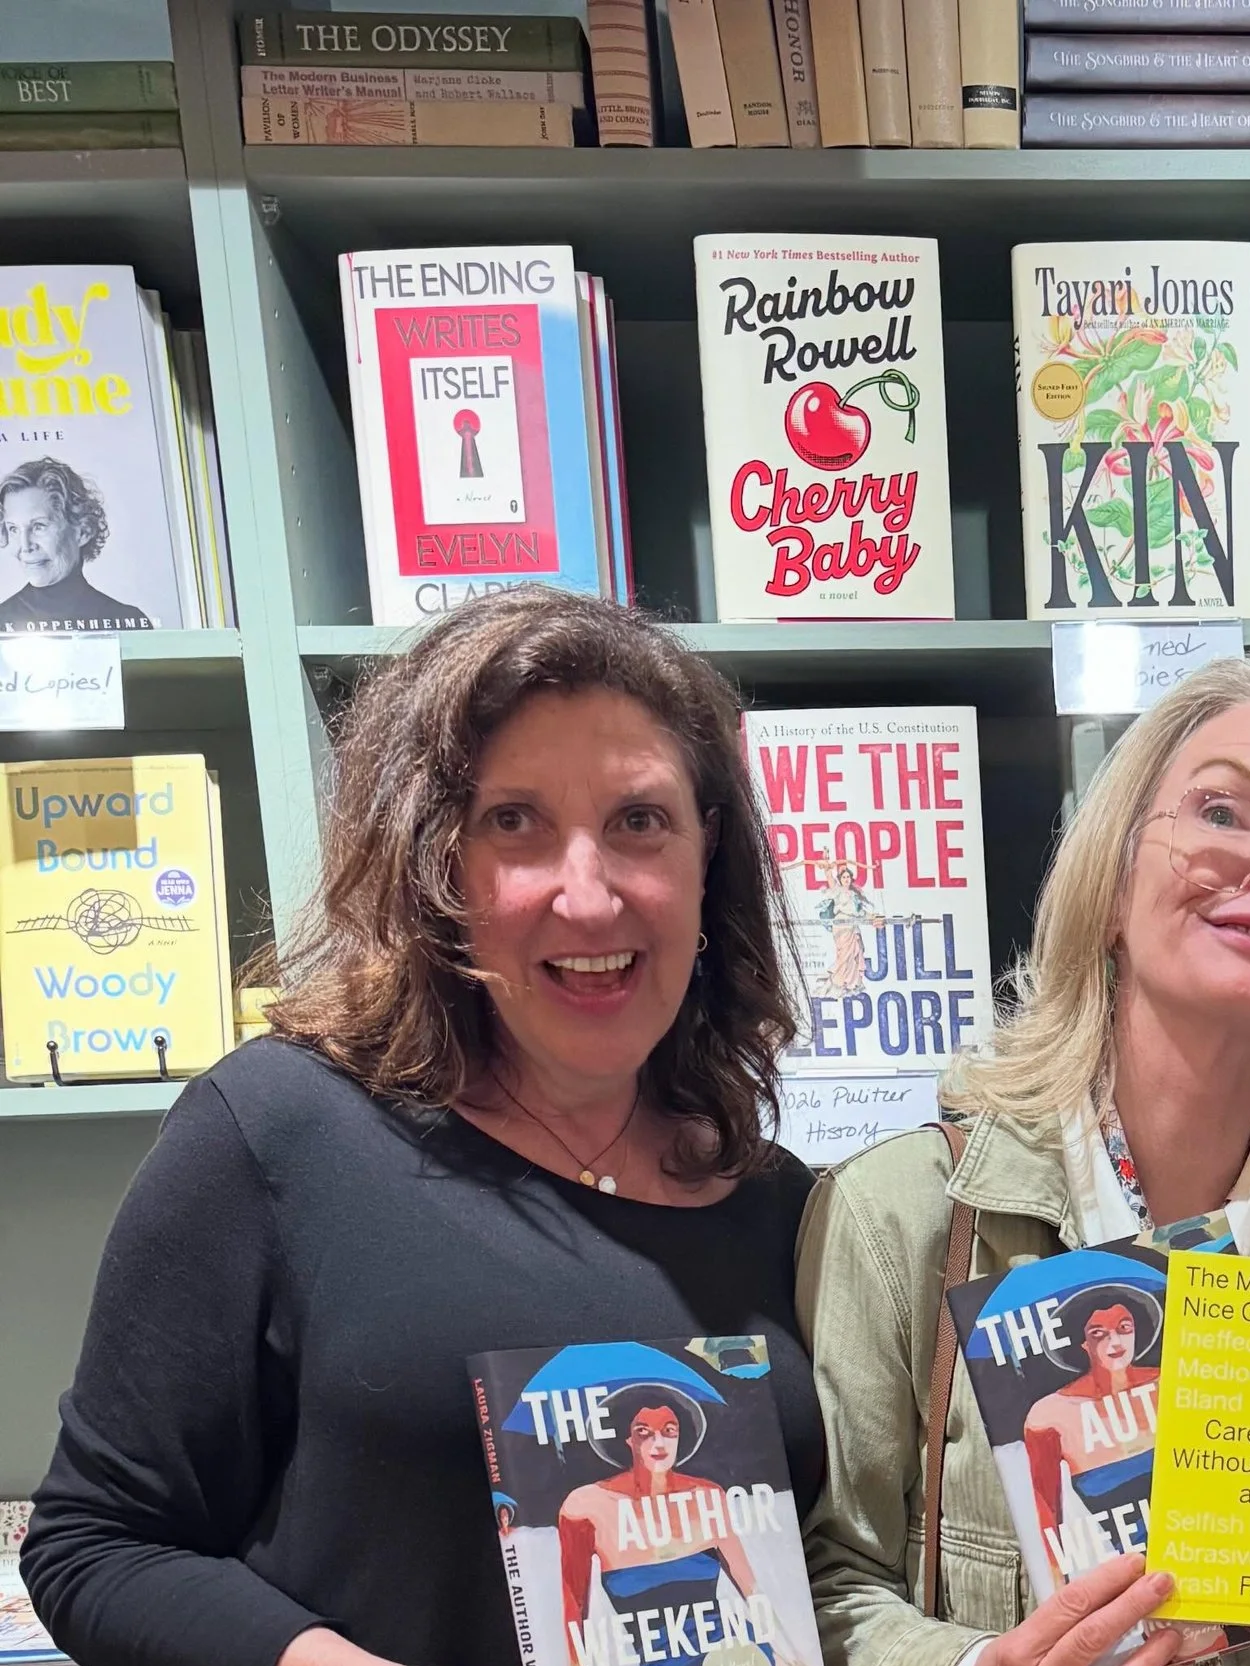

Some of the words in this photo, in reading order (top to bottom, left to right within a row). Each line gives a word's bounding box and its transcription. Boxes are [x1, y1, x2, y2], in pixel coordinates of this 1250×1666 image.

[297, 24, 362, 52] THE
[372, 24, 513, 53] ODYSSEY
[17, 80, 72, 103] BEST
[261, 71, 285, 83] The
[289, 71, 336, 84] Modern
[341, 72, 398, 85] Business
[262, 84, 299, 97] Letter
[302, 84, 352, 98] Writer's
[355, 86, 402, 99] Manual
[726, 250, 750, 260] New
[753, 250, 779, 261] York
[782, 250, 814, 261] Times
[816, 250, 878, 263] Bestselling
[881, 253, 920, 263] Author
[354, 263, 415, 300] THE
[421, 259, 556, 298] ENDING
[1035, 266, 1132, 329] Tayari
[1144, 265, 1235, 317] Jones
[719, 269, 916, 336] Rainbow
[394, 313, 522, 350] WRITES
[758, 315, 917, 384] Rowell
[420, 365, 509, 401] ITSELF
[22, 431, 65, 442] LIFE
[730, 459, 919, 533] Cherry
[1037, 441, 1240, 609] KIN
[416, 532, 539, 567] EVELYN
[765, 520, 921, 598] Baby
[760, 725, 770, 736] A
[774, 724, 817, 739] History
[821, 724, 833, 735] of
[836, 723, 854, 735] the
[858, 723, 883, 734] U.S.
[887, 721, 960, 735] Constitution
[759, 745, 847, 813] WE
[858, 742, 964, 811] THE
[15, 783, 174, 828] Upward
[36, 837, 158, 873] Bound
[765, 820, 968, 891] PEOPLE
[157, 885, 193, 897] JENNA
[864, 914, 973, 982] JILL
[34, 962, 176, 1005] Woody
[47, 1020, 173, 1053] Brown
[833, 1086, 912, 1108] Pulitzer
[1186, 1266, 1229, 1289] The
[1183, 1296, 1234, 1321] Nice
[976, 1298, 1072, 1367] THE
[521, 1386, 616, 1446] THE
[1175, 1388, 1243, 1413] Bland
[473, 1378, 489, 1425] LAURA
[483, 1428, 501, 1484] ZIGMAN
[617, 1483, 782, 1551] AUTHOR
[1165, 1510, 1245, 1536] Selfish
[504, 1544, 520, 1580] THE
[512, 1584, 534, 1656] AUTHOR
